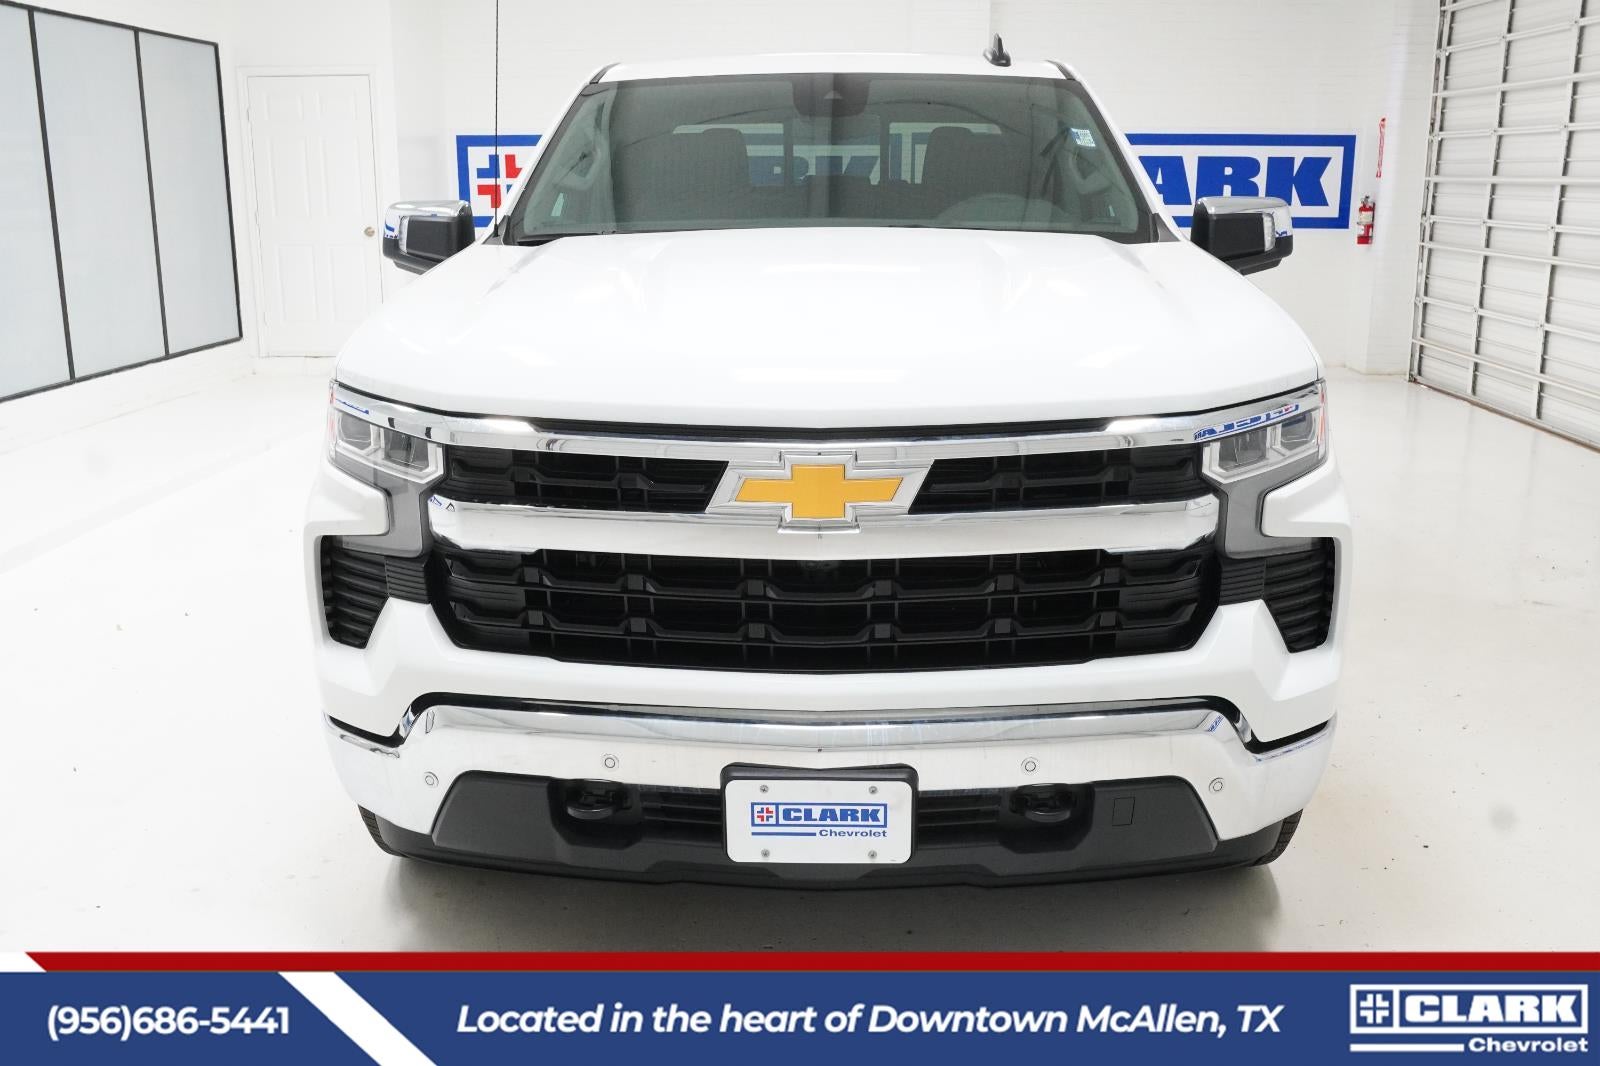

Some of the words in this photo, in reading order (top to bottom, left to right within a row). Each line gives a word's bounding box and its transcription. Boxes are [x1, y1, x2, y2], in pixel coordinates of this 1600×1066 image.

[1138, 155, 1332, 206] ARK
[782, 807, 881, 823] CLARK
[818, 828, 888, 838] Chevrolet
